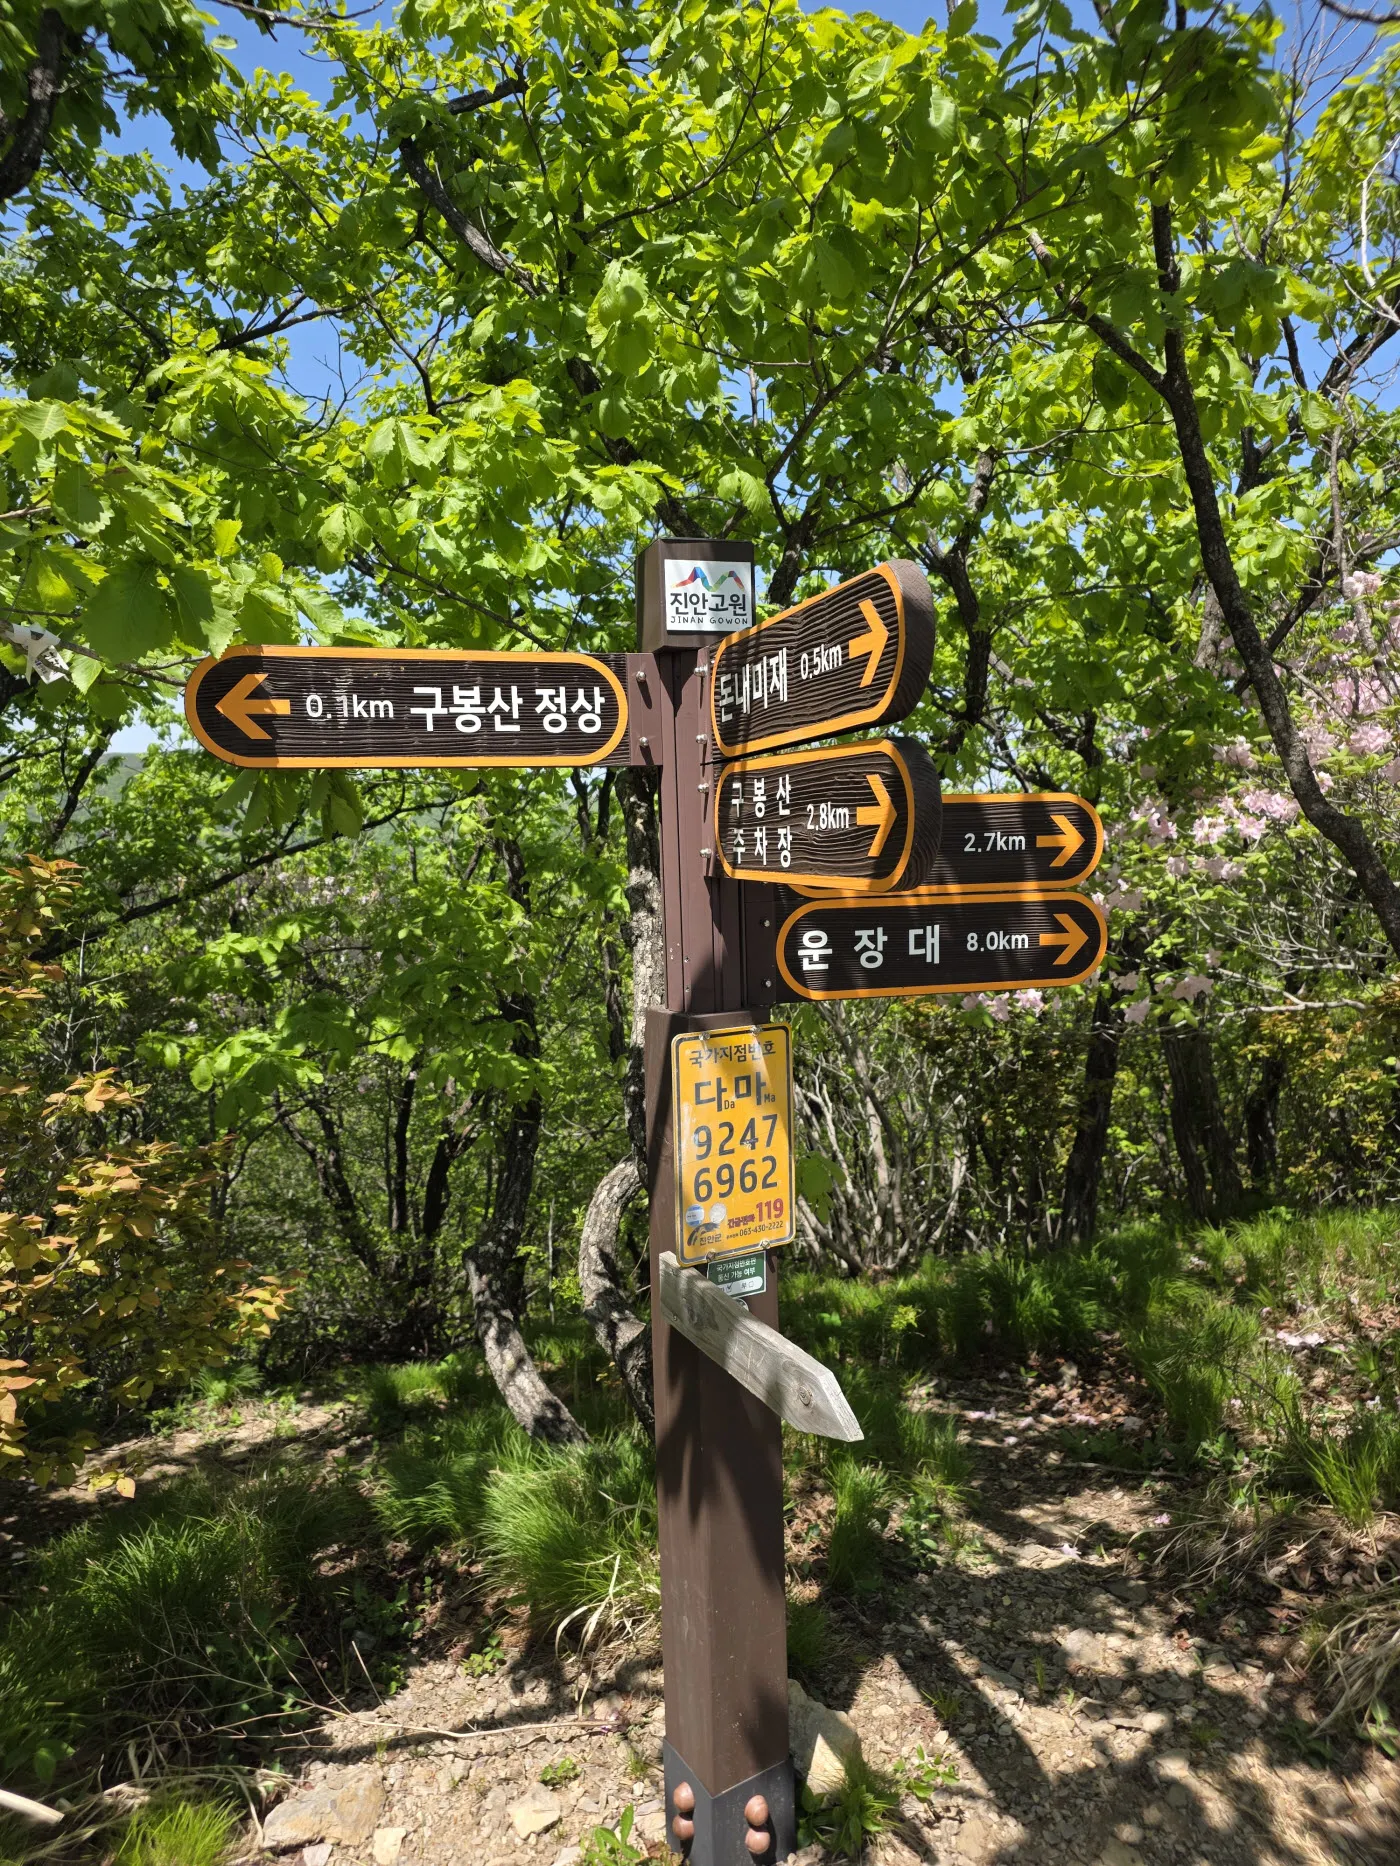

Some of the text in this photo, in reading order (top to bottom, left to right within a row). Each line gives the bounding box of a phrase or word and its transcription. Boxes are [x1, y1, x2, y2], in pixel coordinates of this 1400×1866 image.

[670, 592, 747, 616] 진안고원
[670, 616, 748, 625] JINAN GOWON
[719, 643, 842, 723] 돈내미재 0.5km
[305, 685, 606, 734] 0.1km 구봉산 정상
[731, 774, 792, 818] 구봉산
[806, 802, 850, 831] 2.8km
[732, 825, 792, 868] 주차장
[963, 832, 1026, 852] 2.7km
[797, 924, 1029, 971] 운장대 8.0km
[689, 1040, 776, 1069] 국가지점번호
[693, 1113, 778, 1161] 9247
[693, 1155, 778, 1203] 6962
[756, 1198, 784, 1222] 119
[739, 1221, 784, 1237] 063-430-2222
[743, 1267, 756, 1276] 여부
